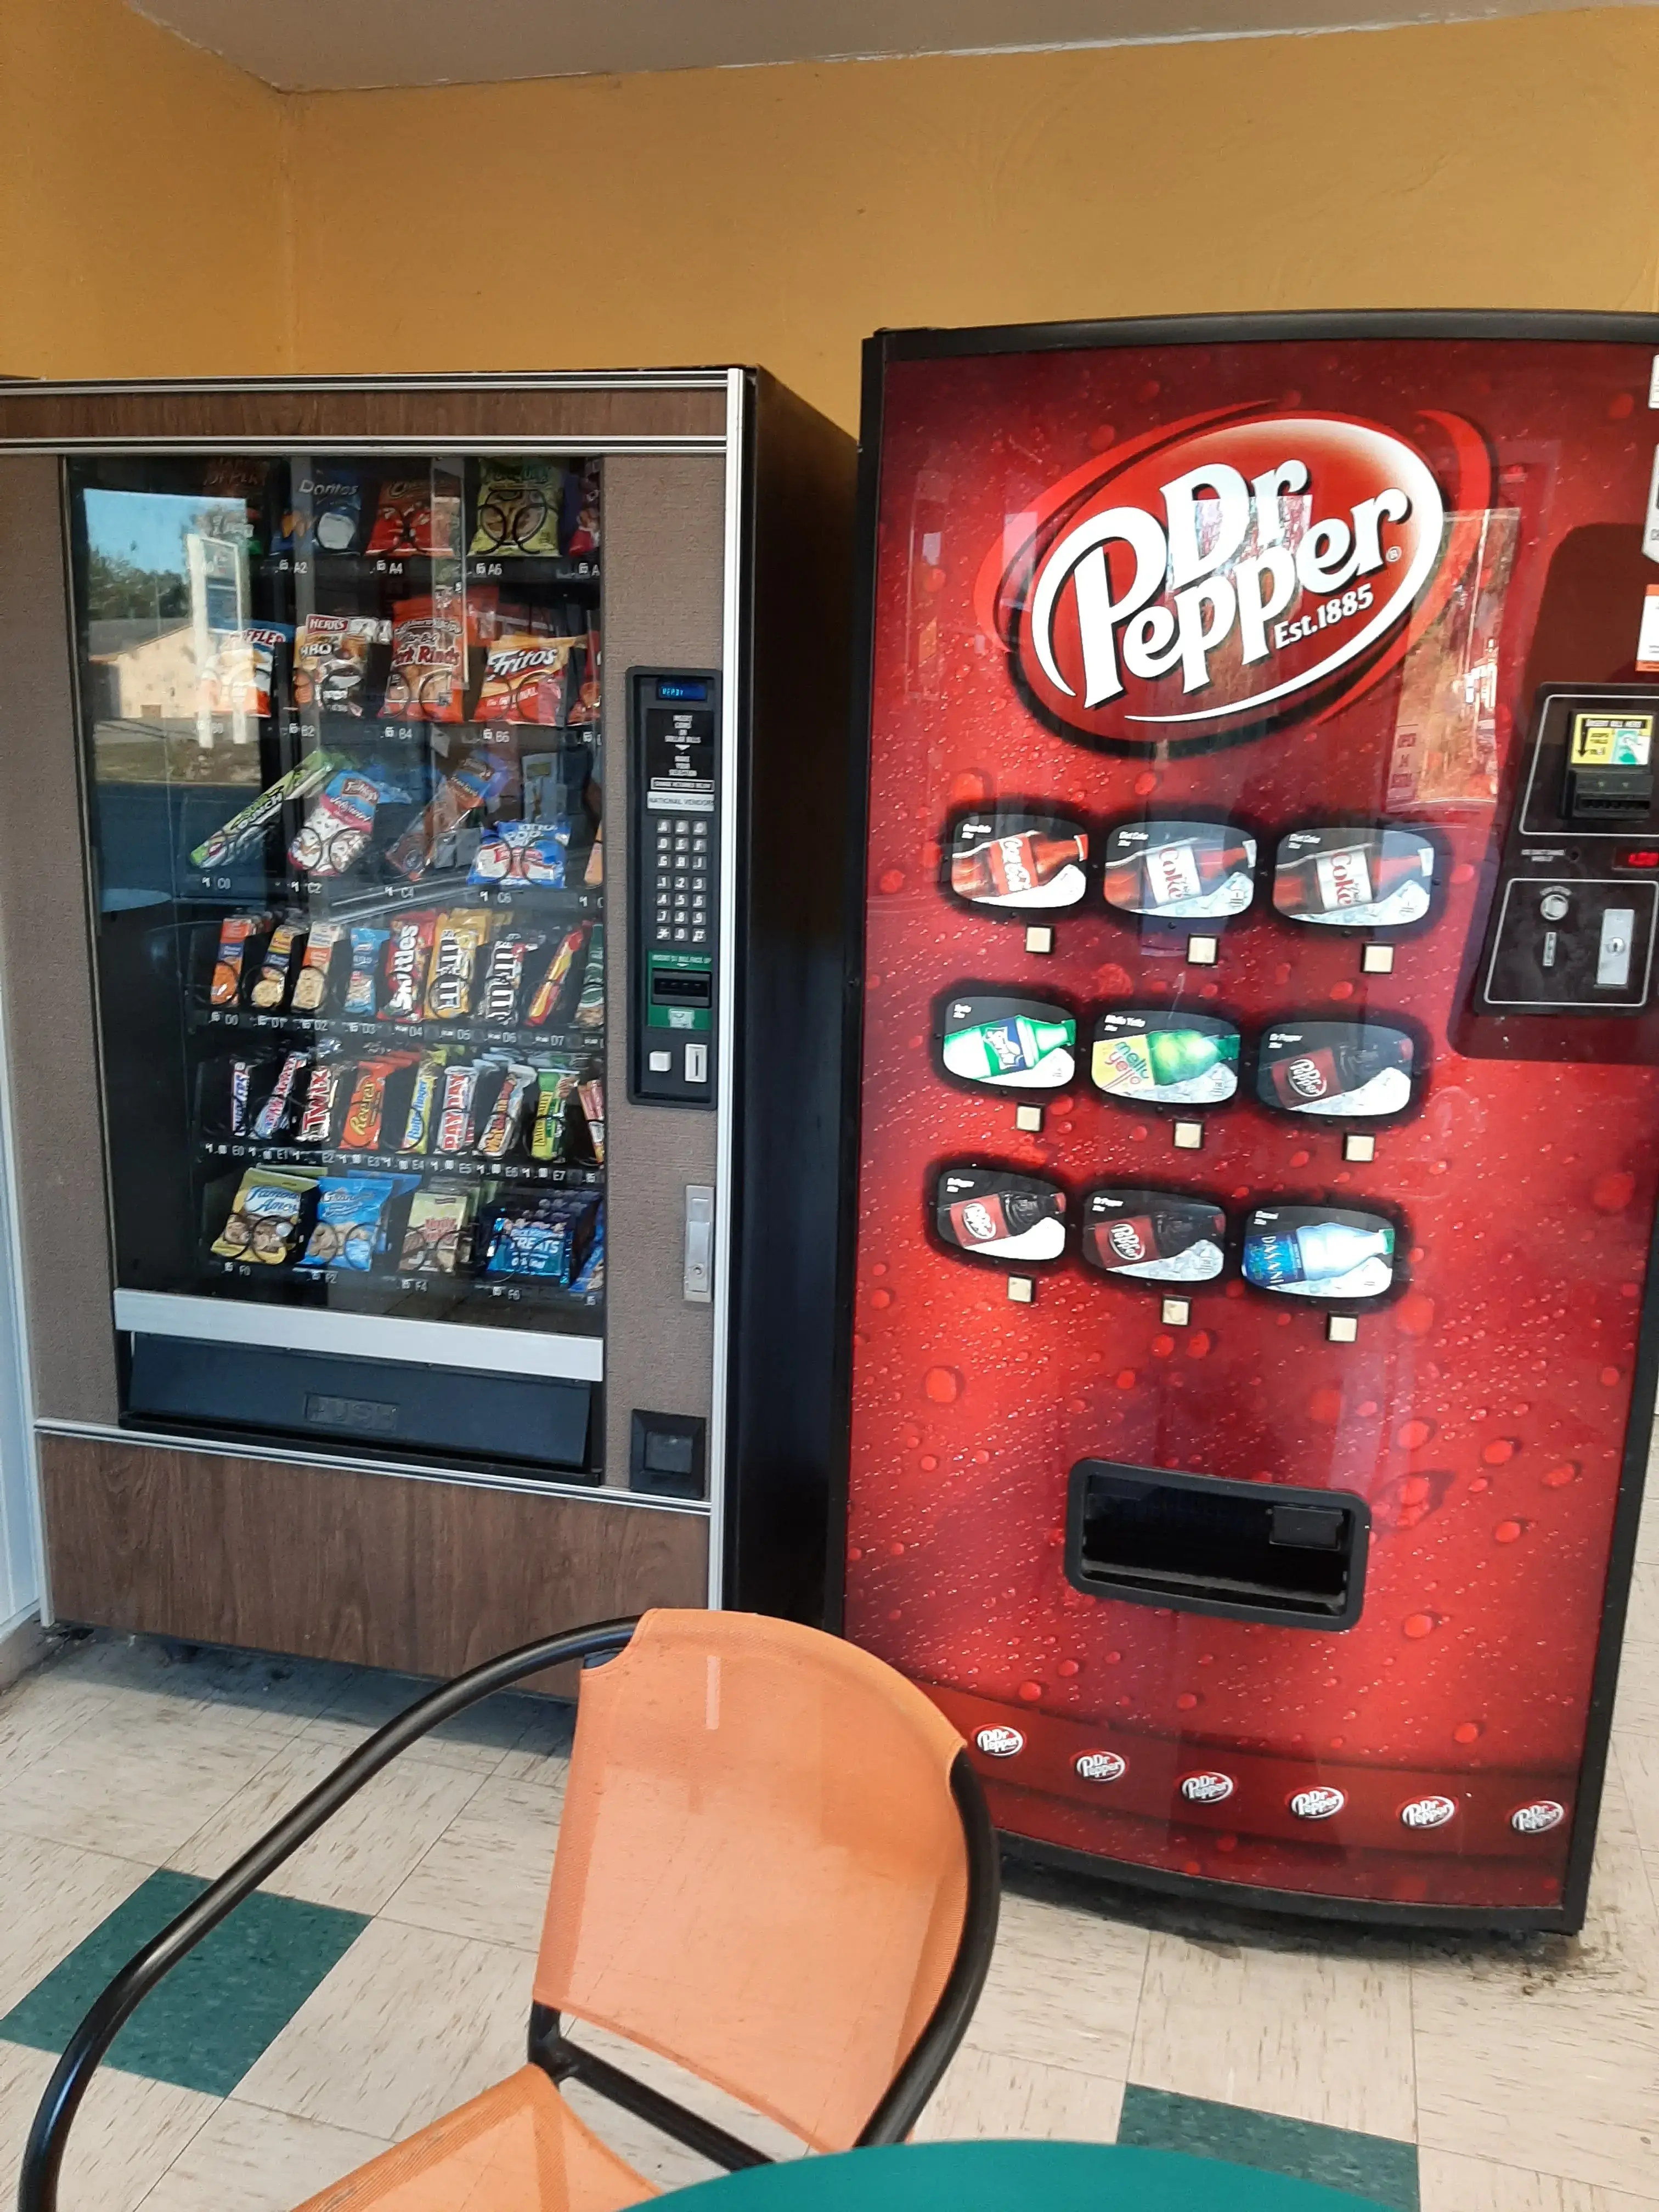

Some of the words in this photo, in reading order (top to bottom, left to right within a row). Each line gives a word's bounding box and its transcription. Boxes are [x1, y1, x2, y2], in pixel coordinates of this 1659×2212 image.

[298, 479, 359, 495] Doritos
[1160, 459, 1310, 590] Dr
[389, 563, 403, 575] A4
[488, 563, 503, 576] A6
[592, 565, 600, 577] A
[1031, 487, 1411, 709] Pepper
[488, 647, 558, 675] Fritos
[1159, 847, 1183, 900] Coke
[1330, 851, 1355, 905] Coke
[387, 924, 419, 1010] Skittles
[303, 1068, 330, 1131] TWIX
[247, 1185, 301, 1202] Famous
[511, 1236, 560, 1254] TREATS
[1261, 1235, 1284, 1284] DASANI
[979, 1729, 1019, 1753] Pepper
[994, 1728, 1009, 1740] Dr
[1079, 1756, 1121, 1778] Pepper
[1093, 1753, 1110, 1765] Dr
[1183, 1777, 1229, 1798] Pepper
[1199, 1775, 1218, 1788] Dr
[1293, 1793, 1340, 1815] Pepper
[1310, 1791, 1328, 1803] Dr
[1420, 1799, 1439, 1810] Dr
[1402, 1803, 1451, 1826] Pepper
[1512, 1808, 1560, 1831] Pepper
[1530, 1804, 1549, 1815] Dr
